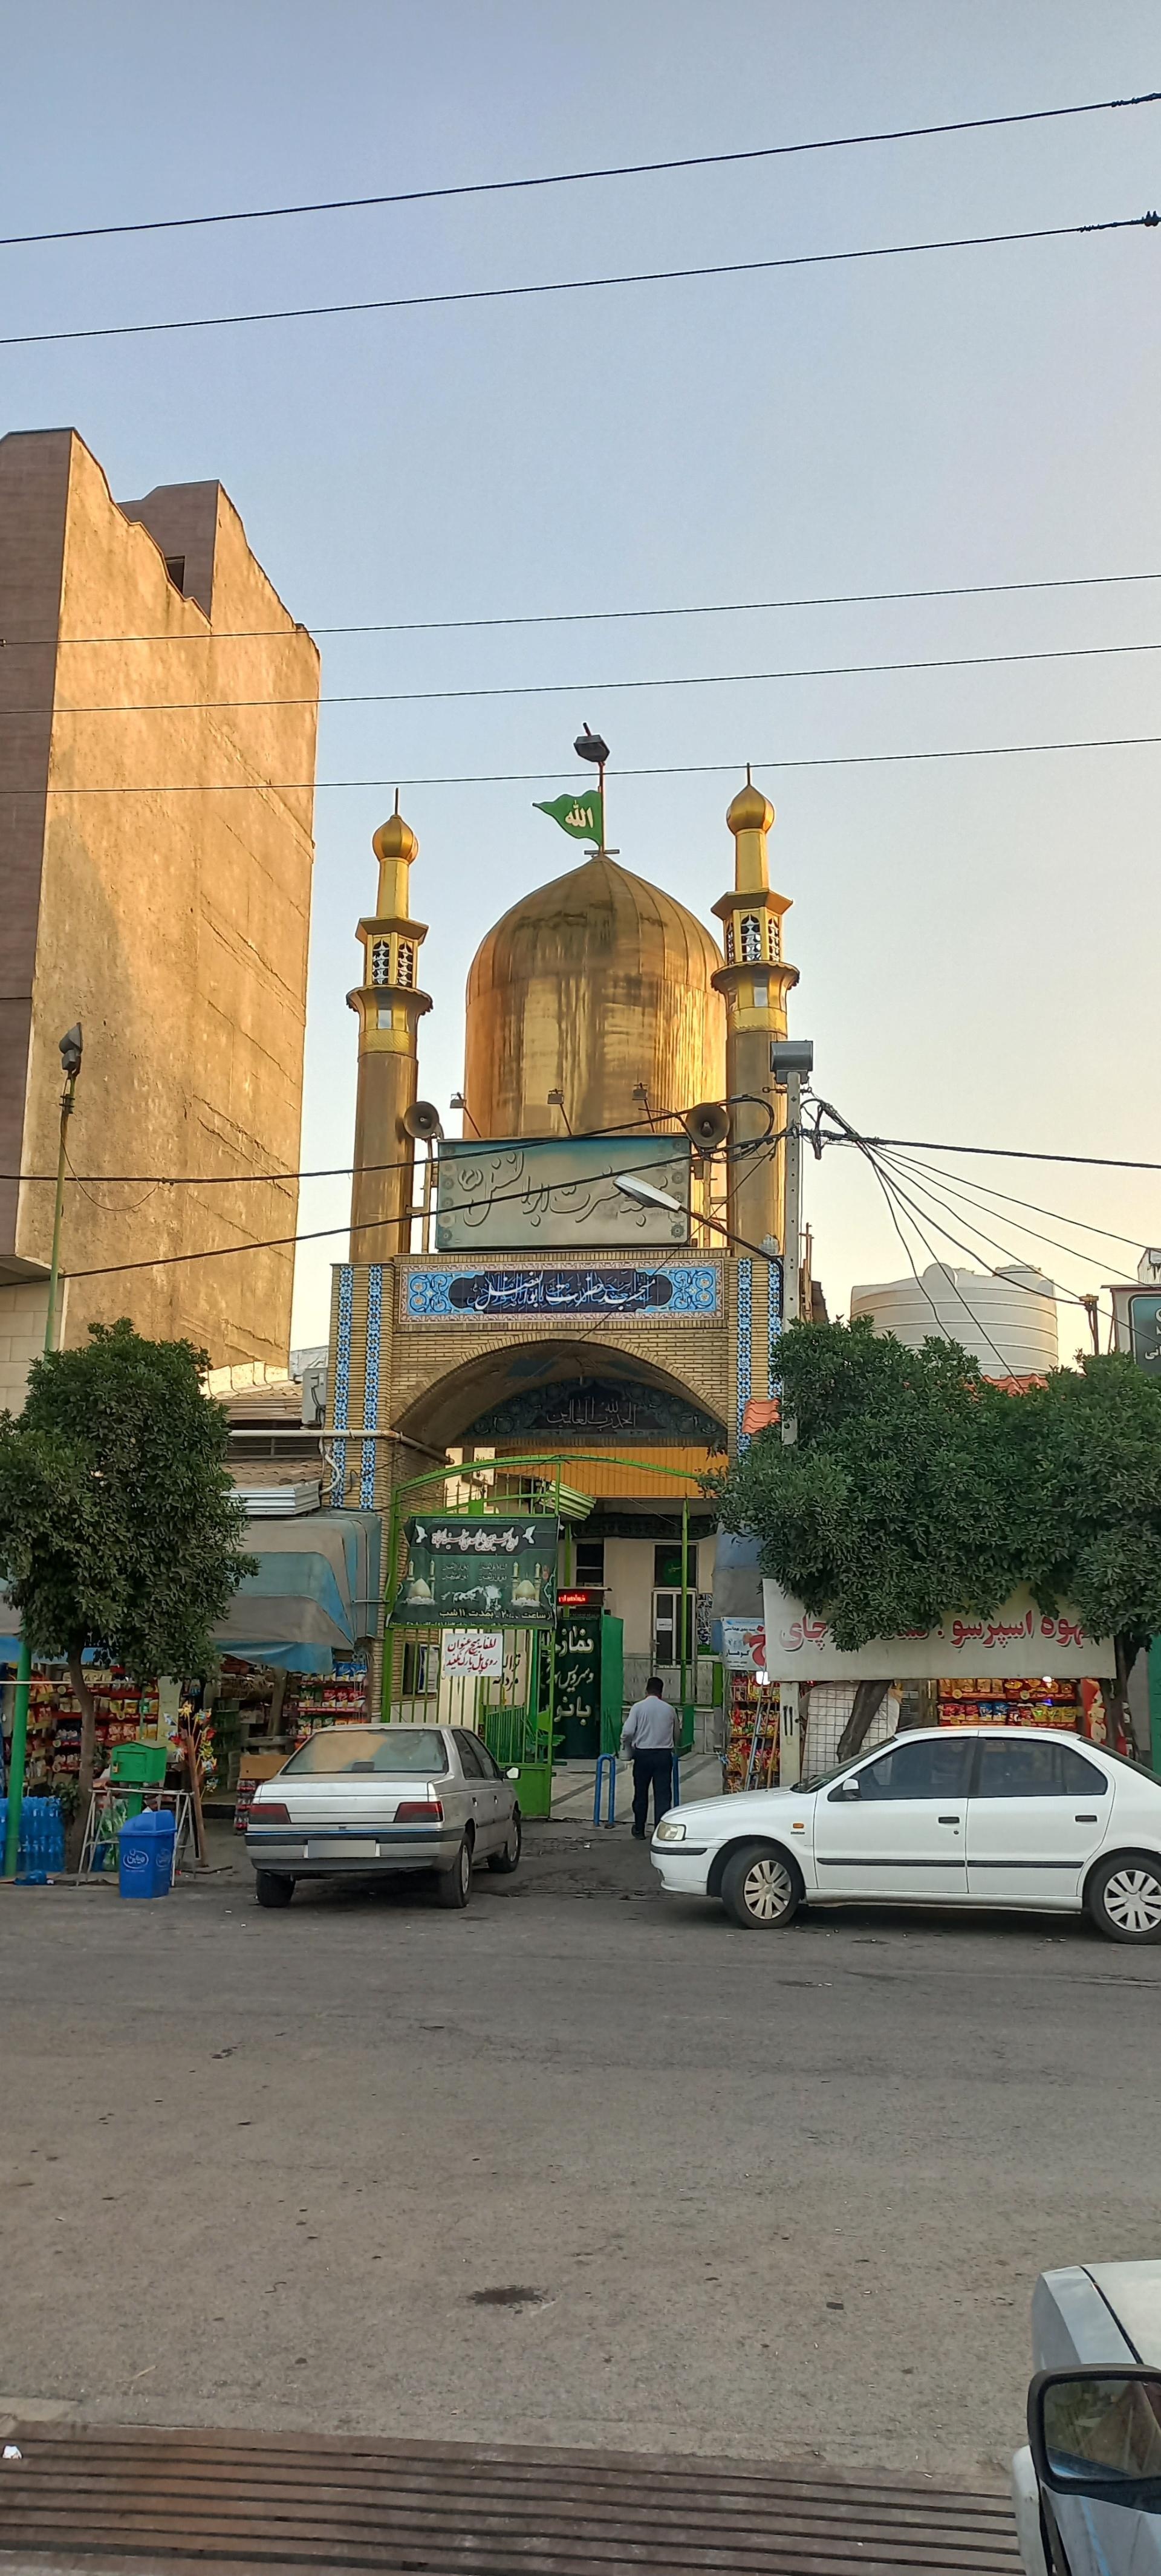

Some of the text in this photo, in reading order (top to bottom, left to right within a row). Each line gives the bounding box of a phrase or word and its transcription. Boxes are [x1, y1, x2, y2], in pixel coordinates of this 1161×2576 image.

[565, 799, 593, 828] الله
[439, 1608, 458, 1618] شب
[522, 1611, 546, 1619] ساعت
[781, 1616, 828, 1652] چای
[951, 1610, 1033, 1648] اسپرسو
[1041, 1615, 1091, 1649] هوه
[447, 1637, 472, 1652] عنوان
[502, 1653, 521, 1671] توال
